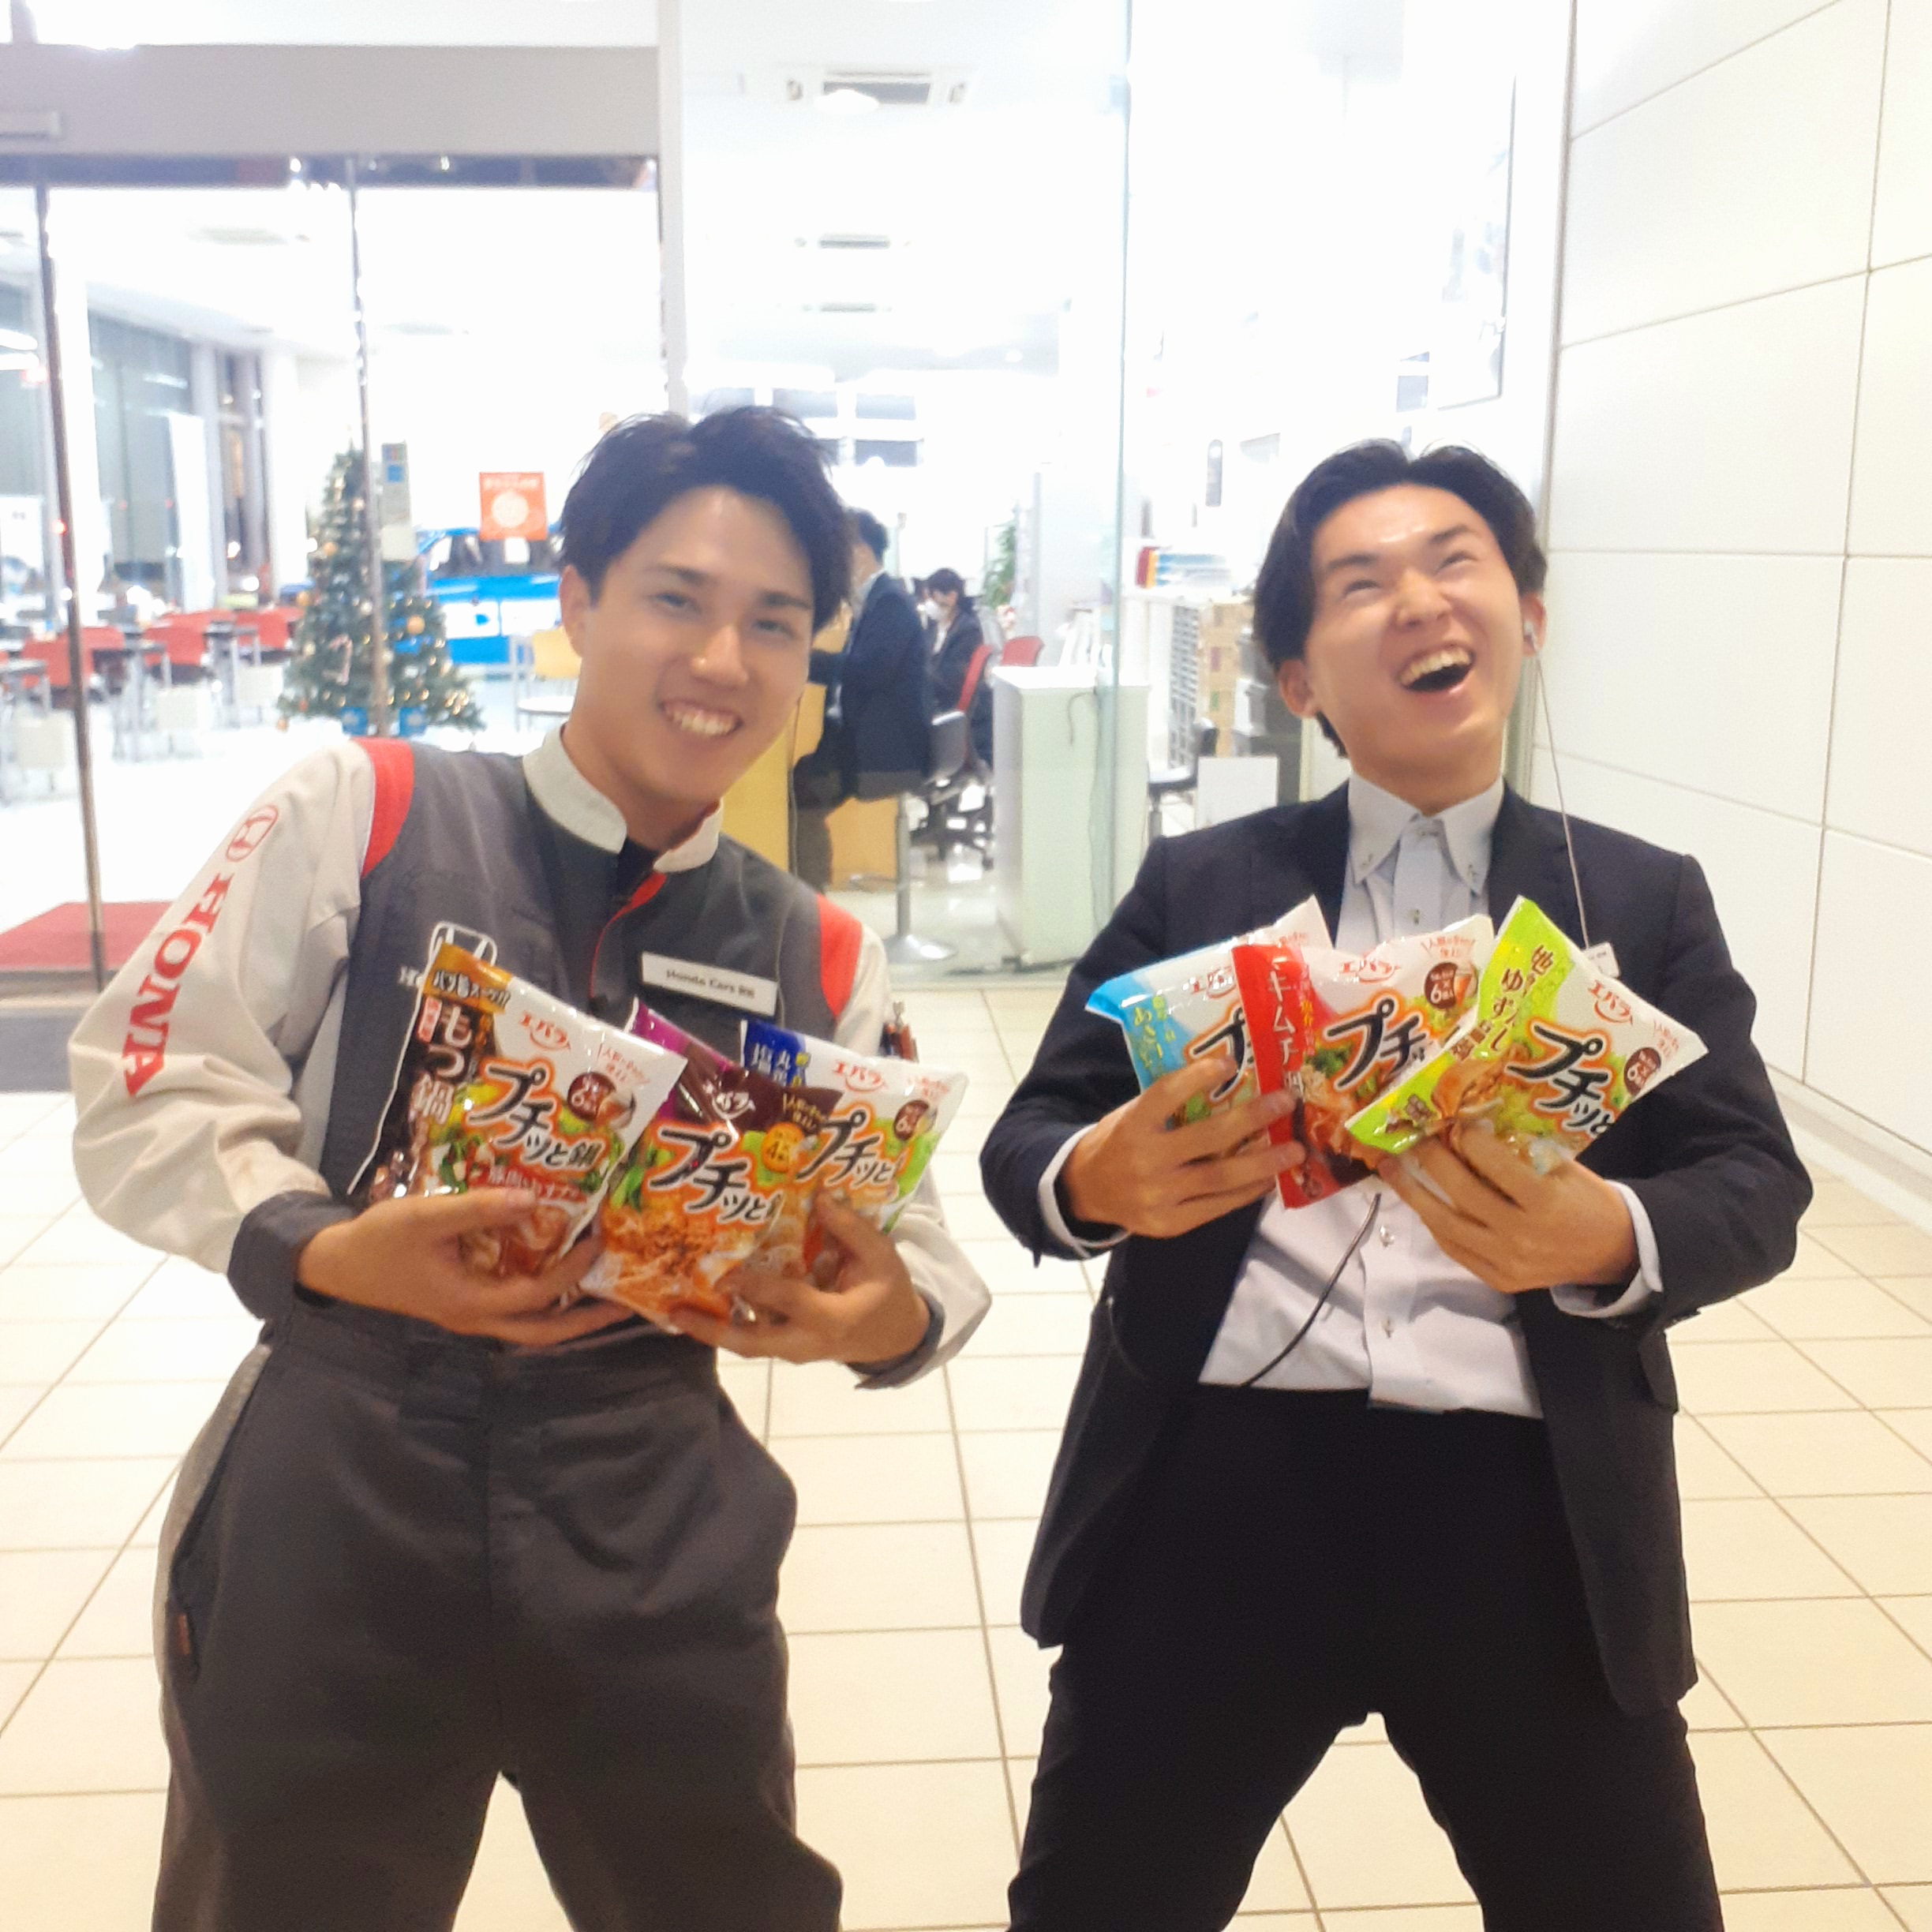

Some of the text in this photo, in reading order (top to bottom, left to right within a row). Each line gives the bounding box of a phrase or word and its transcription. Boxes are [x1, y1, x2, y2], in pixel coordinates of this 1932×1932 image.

[122, 872, 235, 1098] HONA
[1587, 979, 1633, 1020] エバラ
[518, 1012, 571, 1049] エバラ
[833, 1061, 884, 1088] エバラ
[467, 1066, 605, 1168] プチッと鍋
[796, 1109, 901, 1185] プチッと
